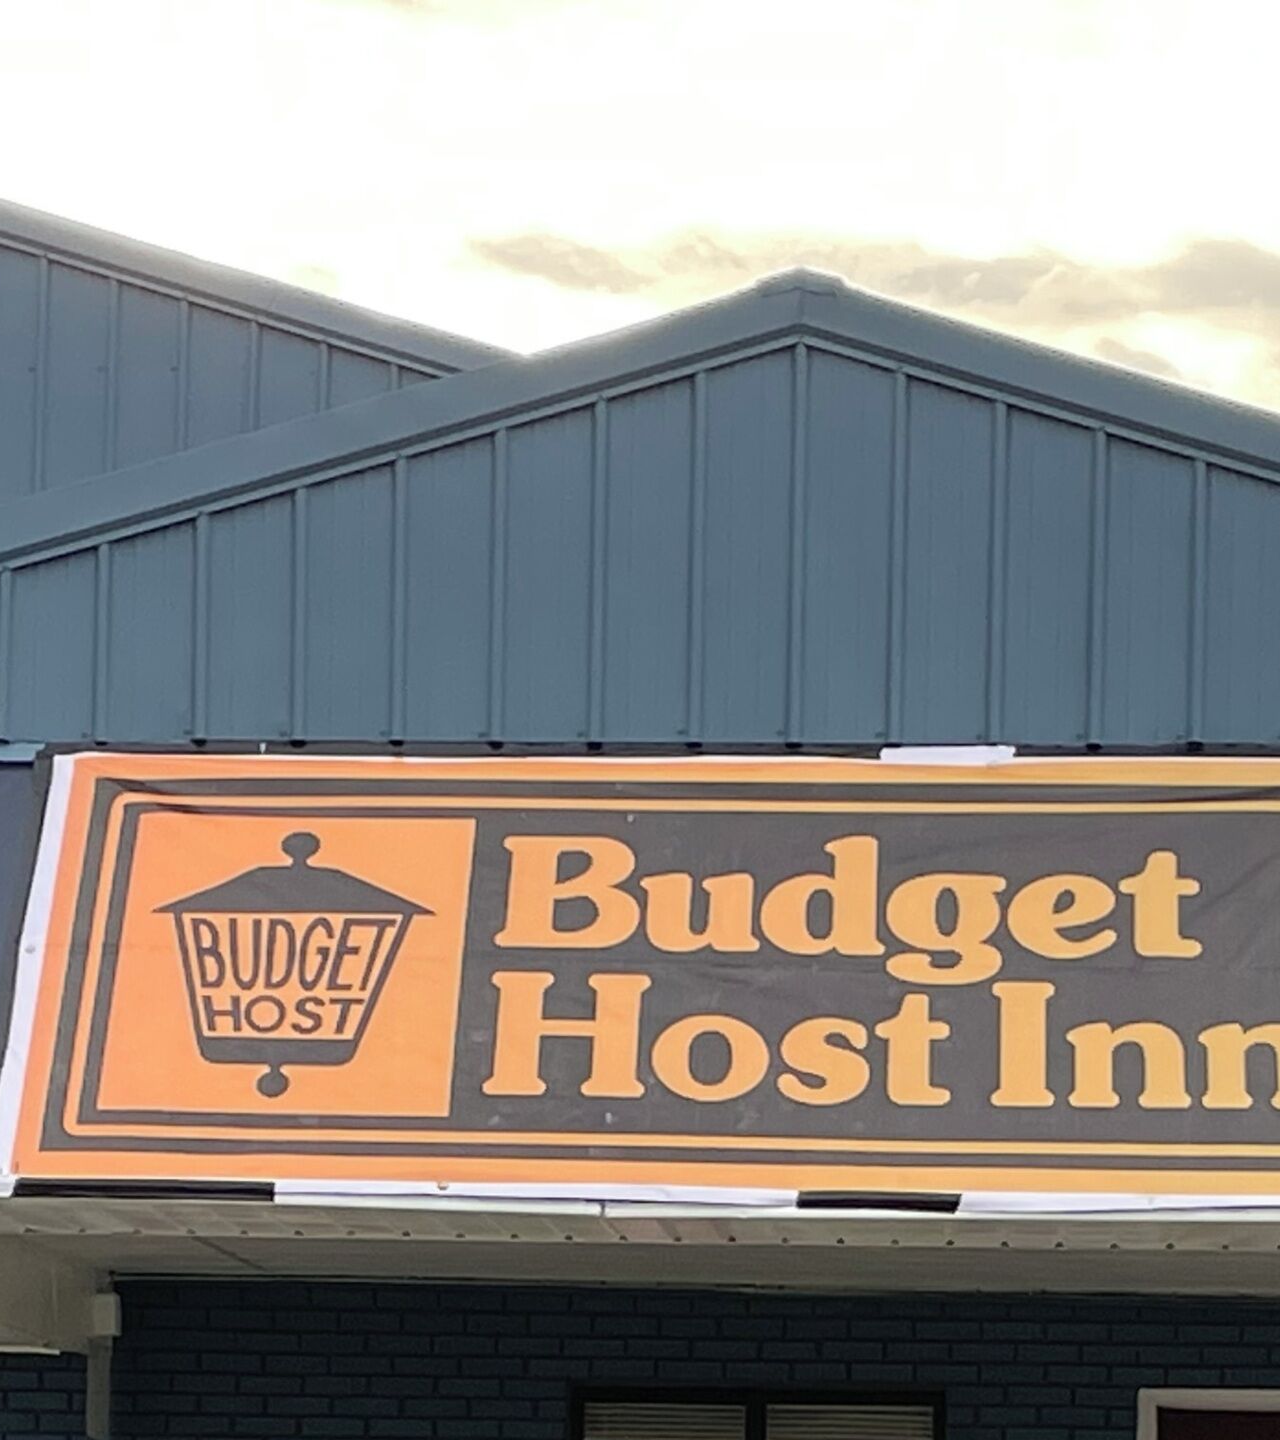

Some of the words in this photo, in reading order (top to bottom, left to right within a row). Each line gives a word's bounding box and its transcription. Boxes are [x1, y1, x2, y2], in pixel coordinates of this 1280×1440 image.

[190, 917, 398, 991] BUDGET
[493, 834, 1204, 986] Budget
[201, 995, 366, 1035] HOST
[481, 970, 952, 1107] Host
